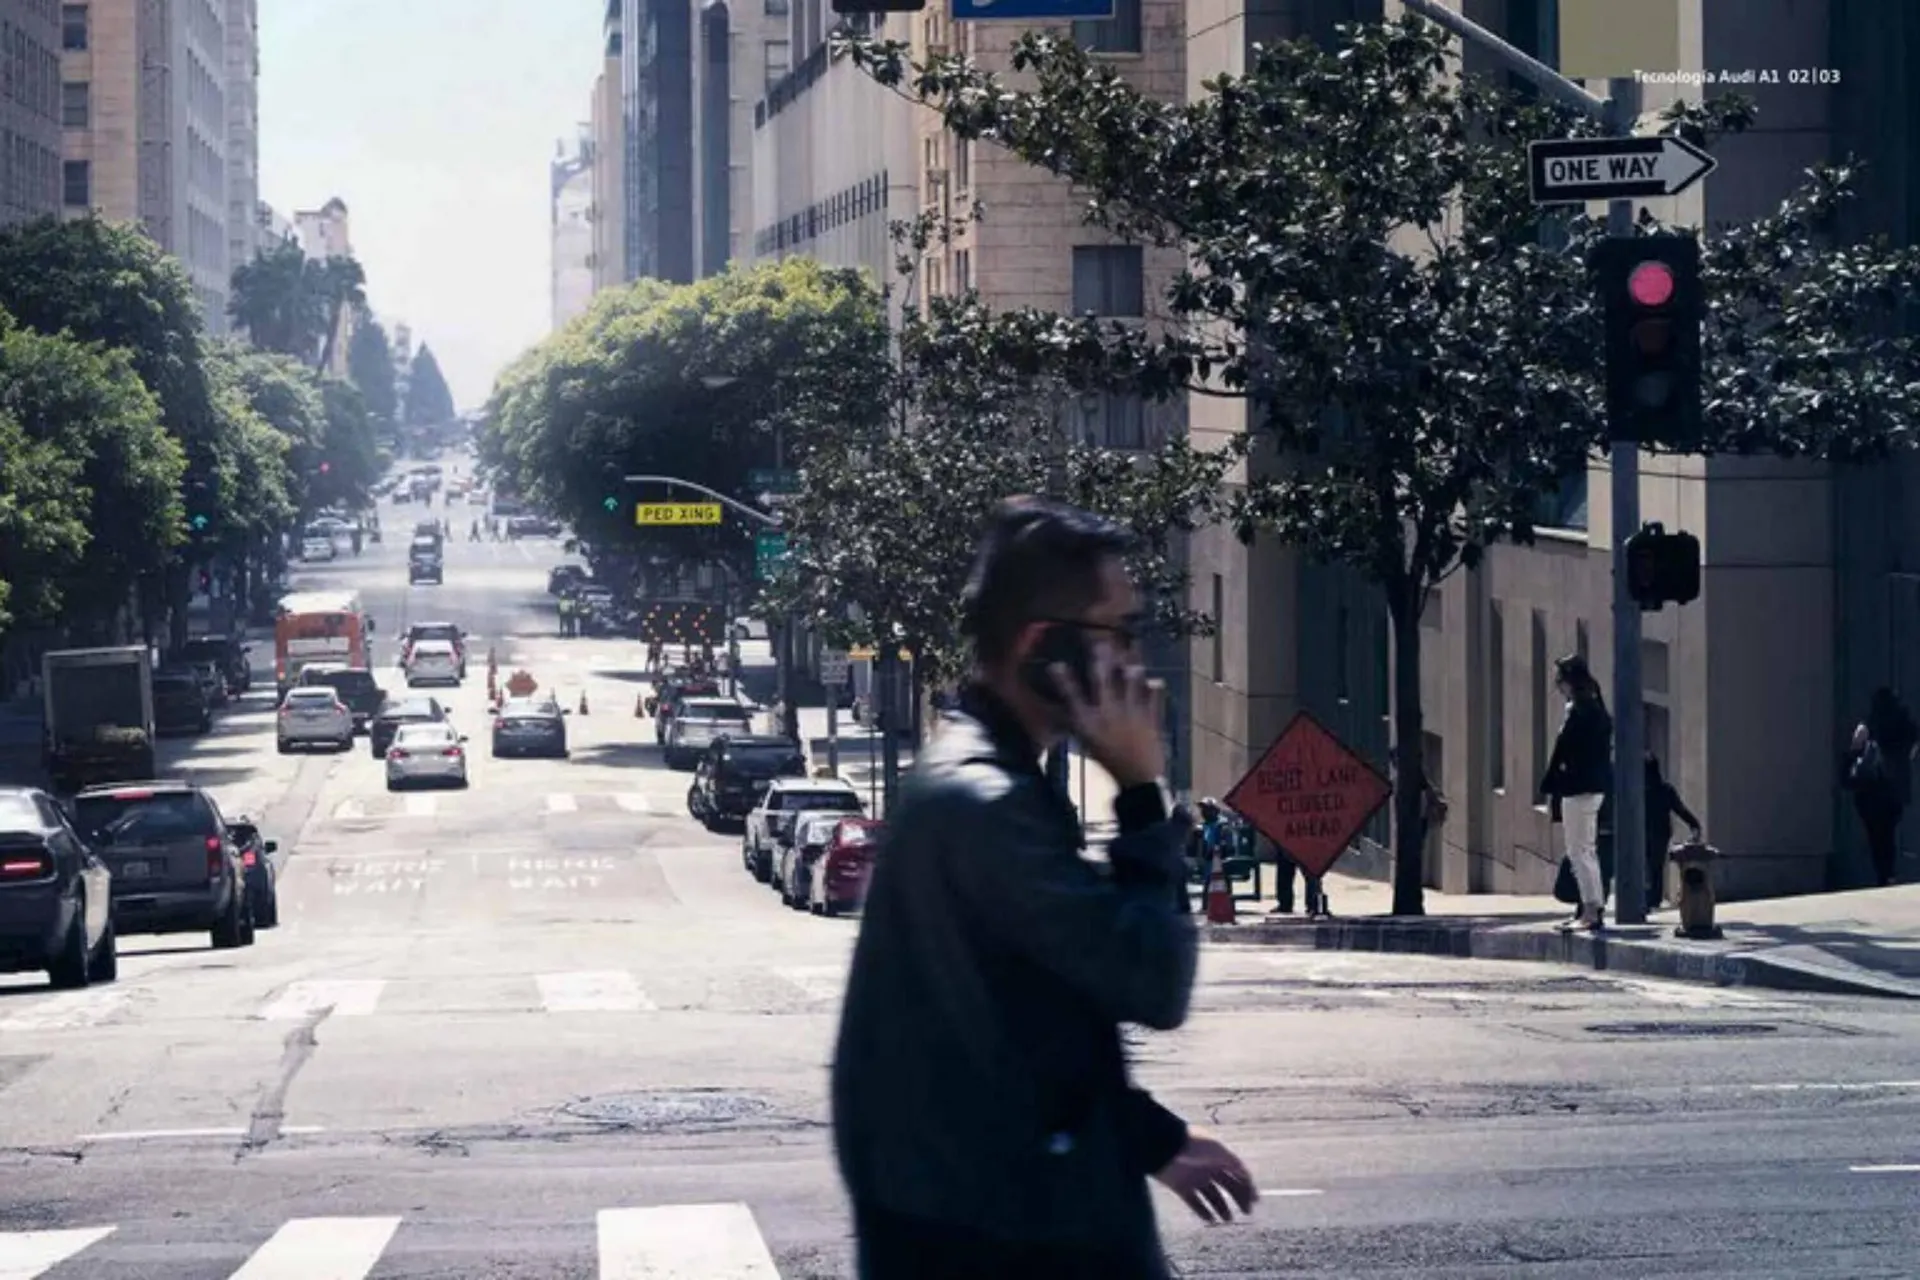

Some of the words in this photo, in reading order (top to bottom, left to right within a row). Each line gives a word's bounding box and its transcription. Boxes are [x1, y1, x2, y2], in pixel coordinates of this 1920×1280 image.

[1550, 159, 1601, 182] ONE
[1608, 156, 1659, 179] WAY
[643, 506, 674, 521] PED
[679, 506, 715, 520] XING
[1285, 816, 1343, 839] AHEAD
